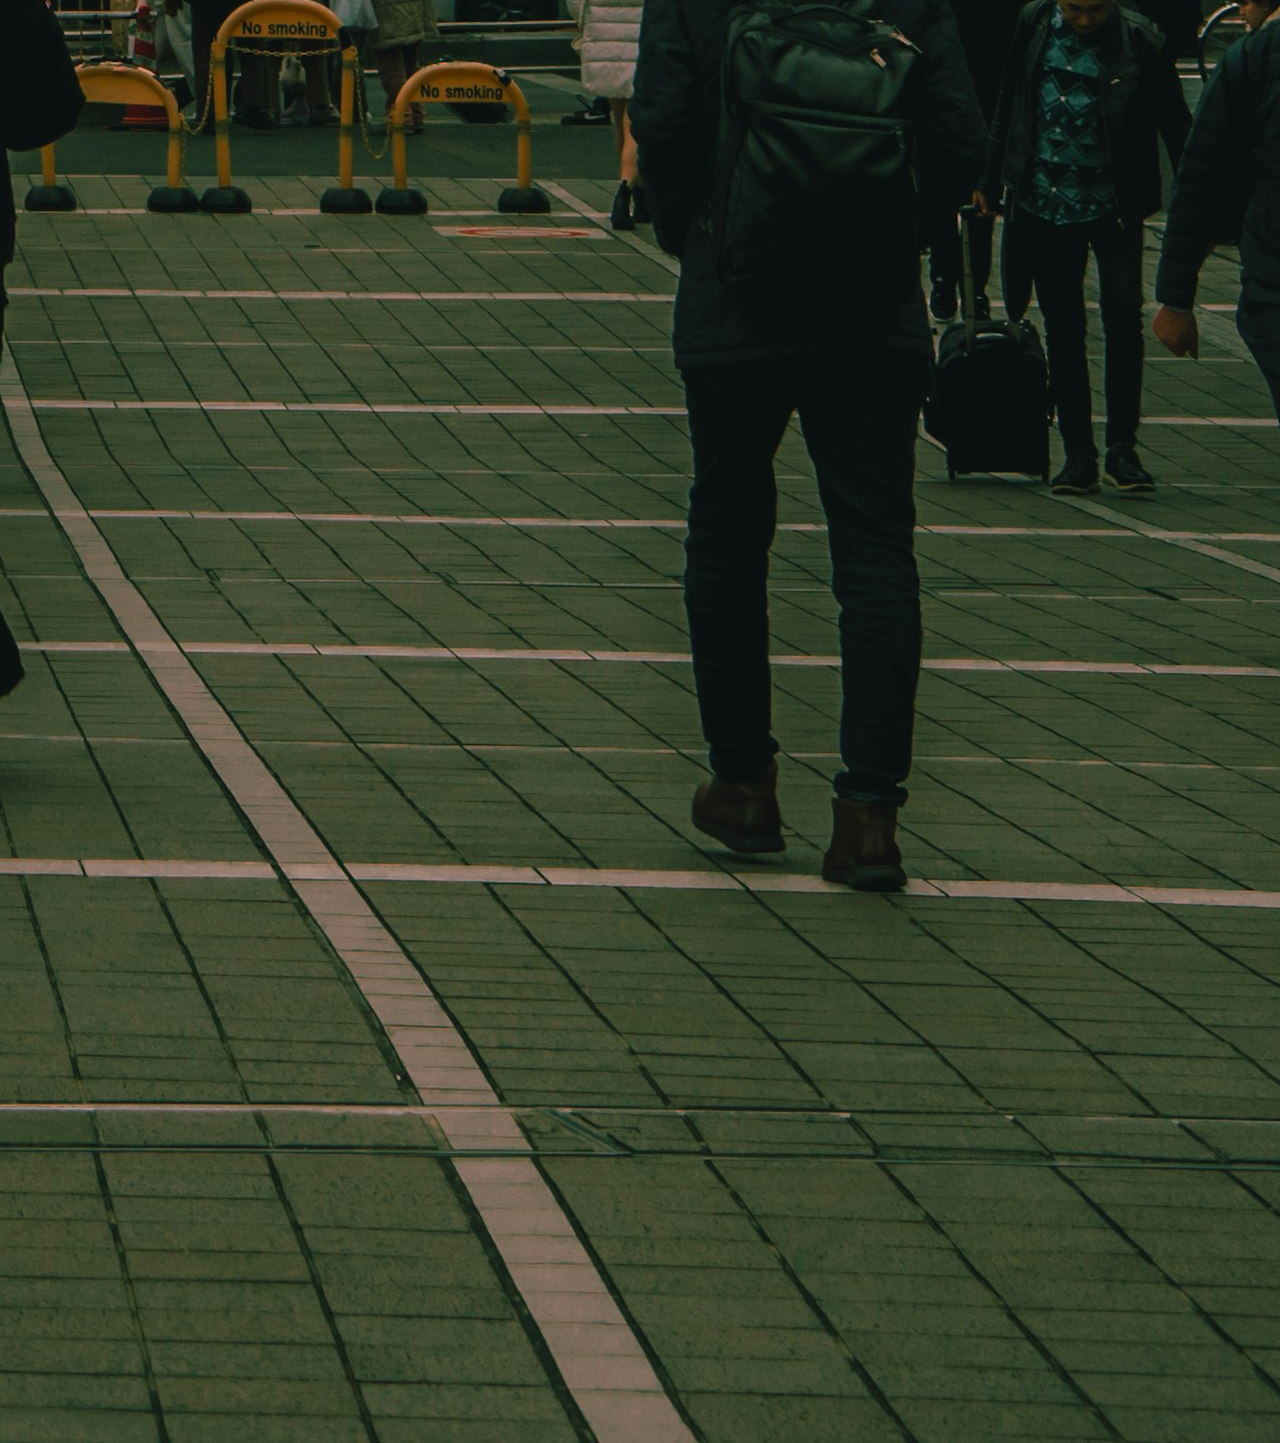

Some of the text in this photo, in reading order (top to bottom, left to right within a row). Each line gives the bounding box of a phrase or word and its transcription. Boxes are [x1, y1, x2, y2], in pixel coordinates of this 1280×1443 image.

[242, 20, 328, 38] No smoking
[421, 84, 503, 101] No smoking
